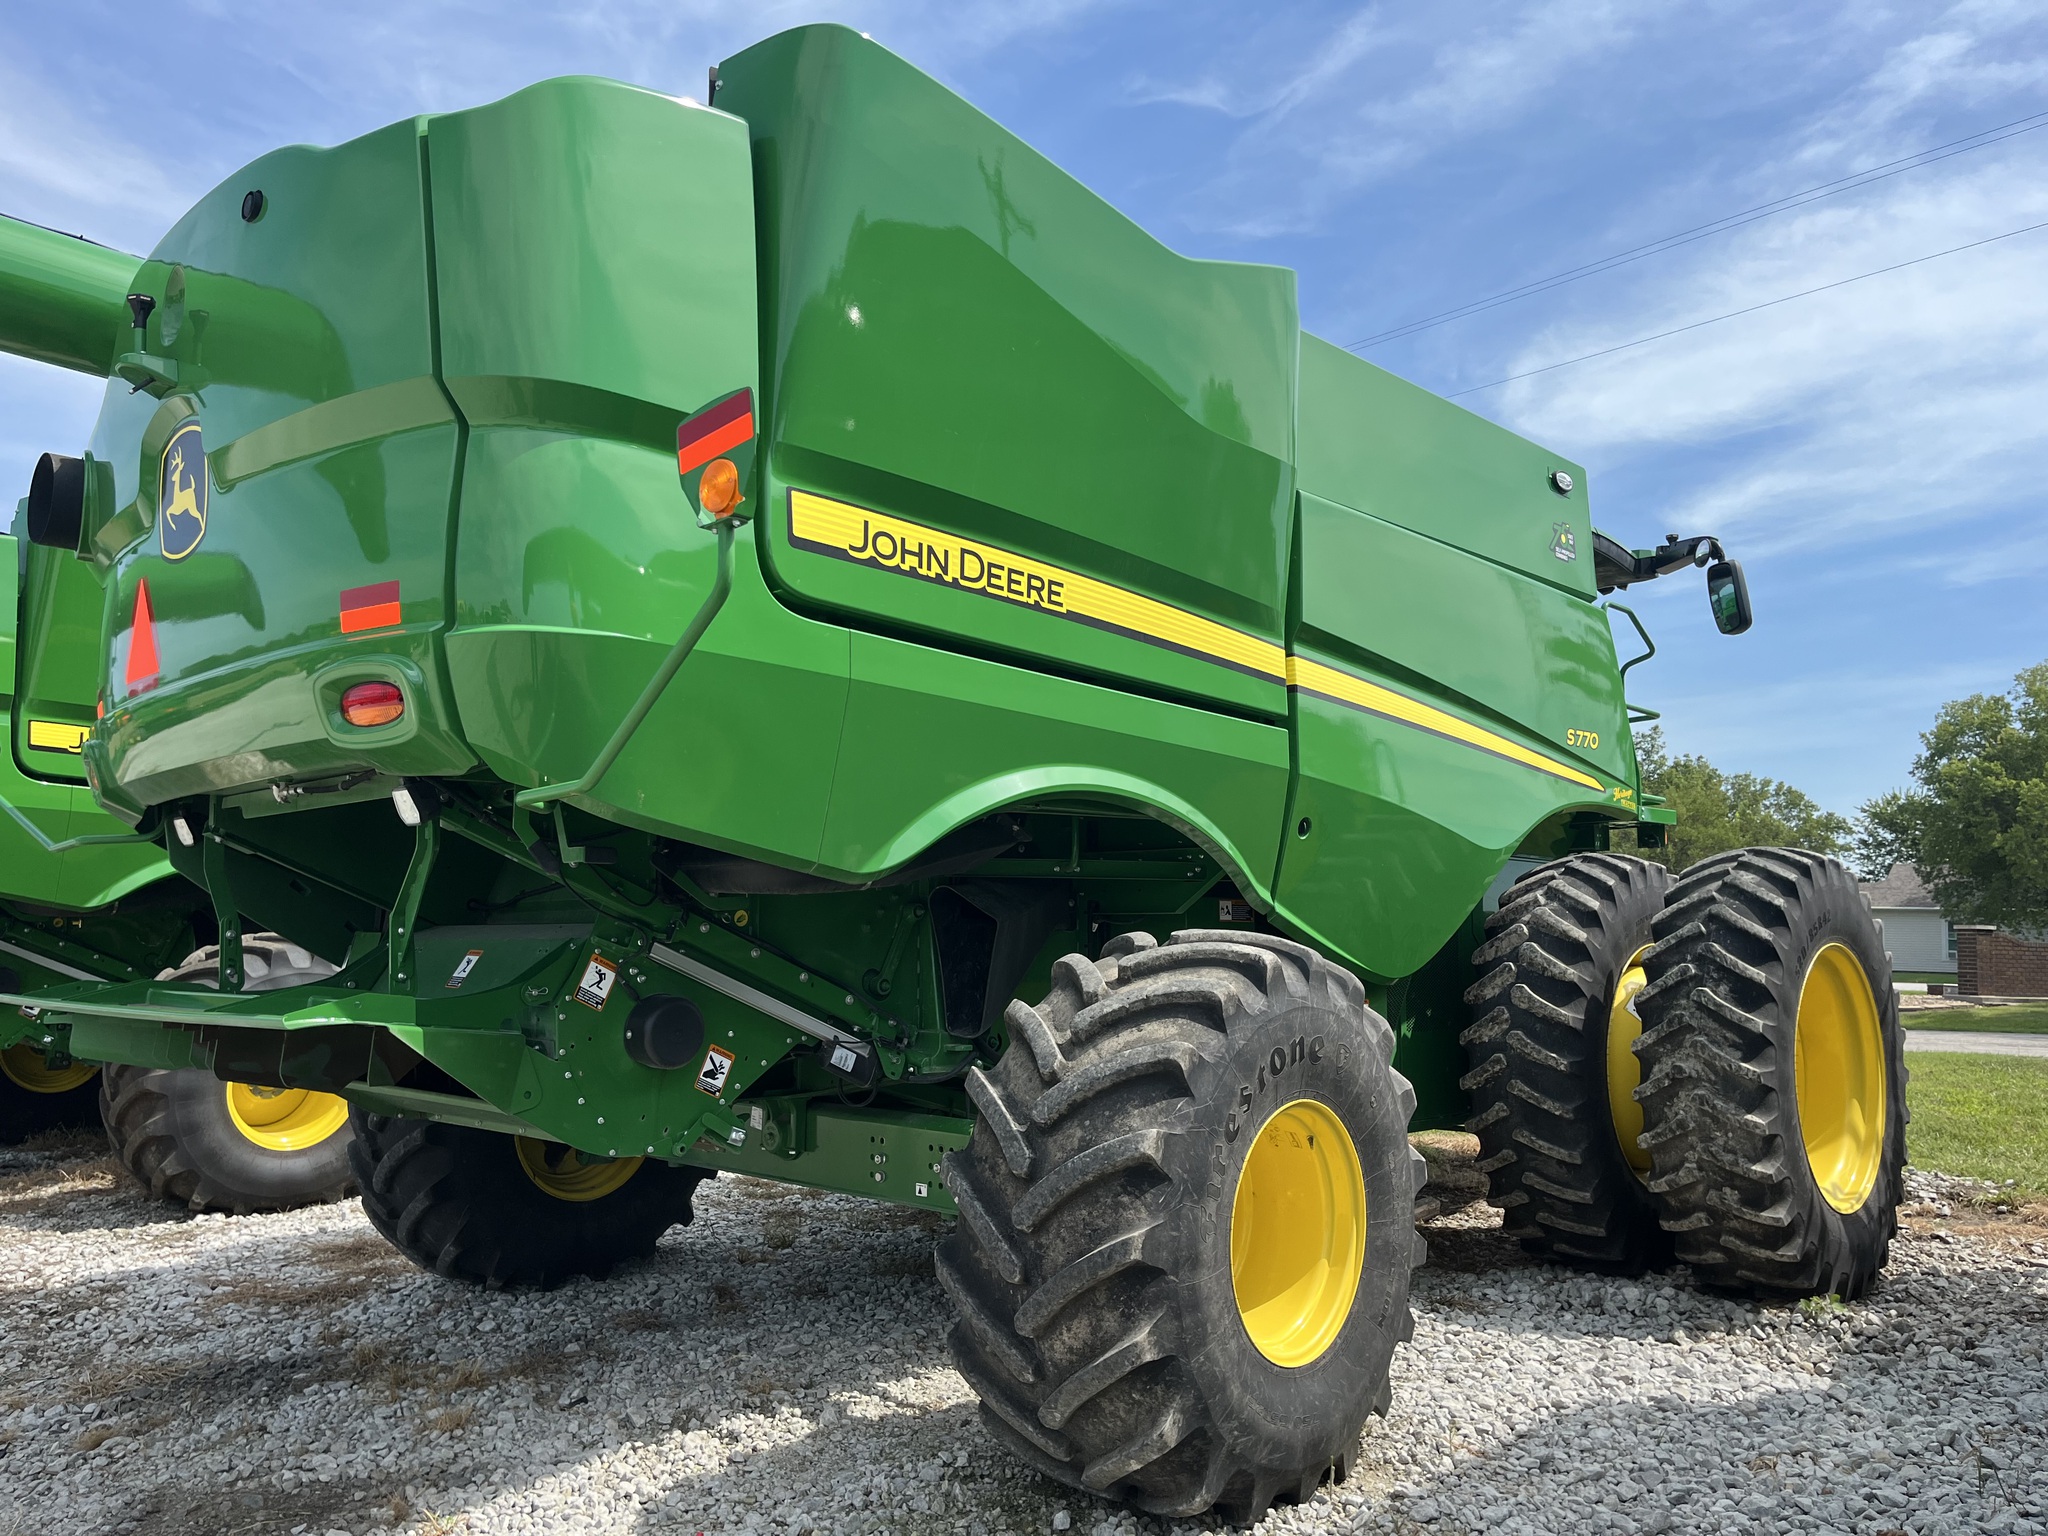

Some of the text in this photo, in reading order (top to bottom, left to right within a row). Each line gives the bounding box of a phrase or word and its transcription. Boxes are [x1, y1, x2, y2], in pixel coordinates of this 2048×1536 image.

[849, 519, 1065, 608] JOHN DEERE
[1566, 728, 1599, 750] S770
[1200, 1035, 1325, 1244] Firestone
